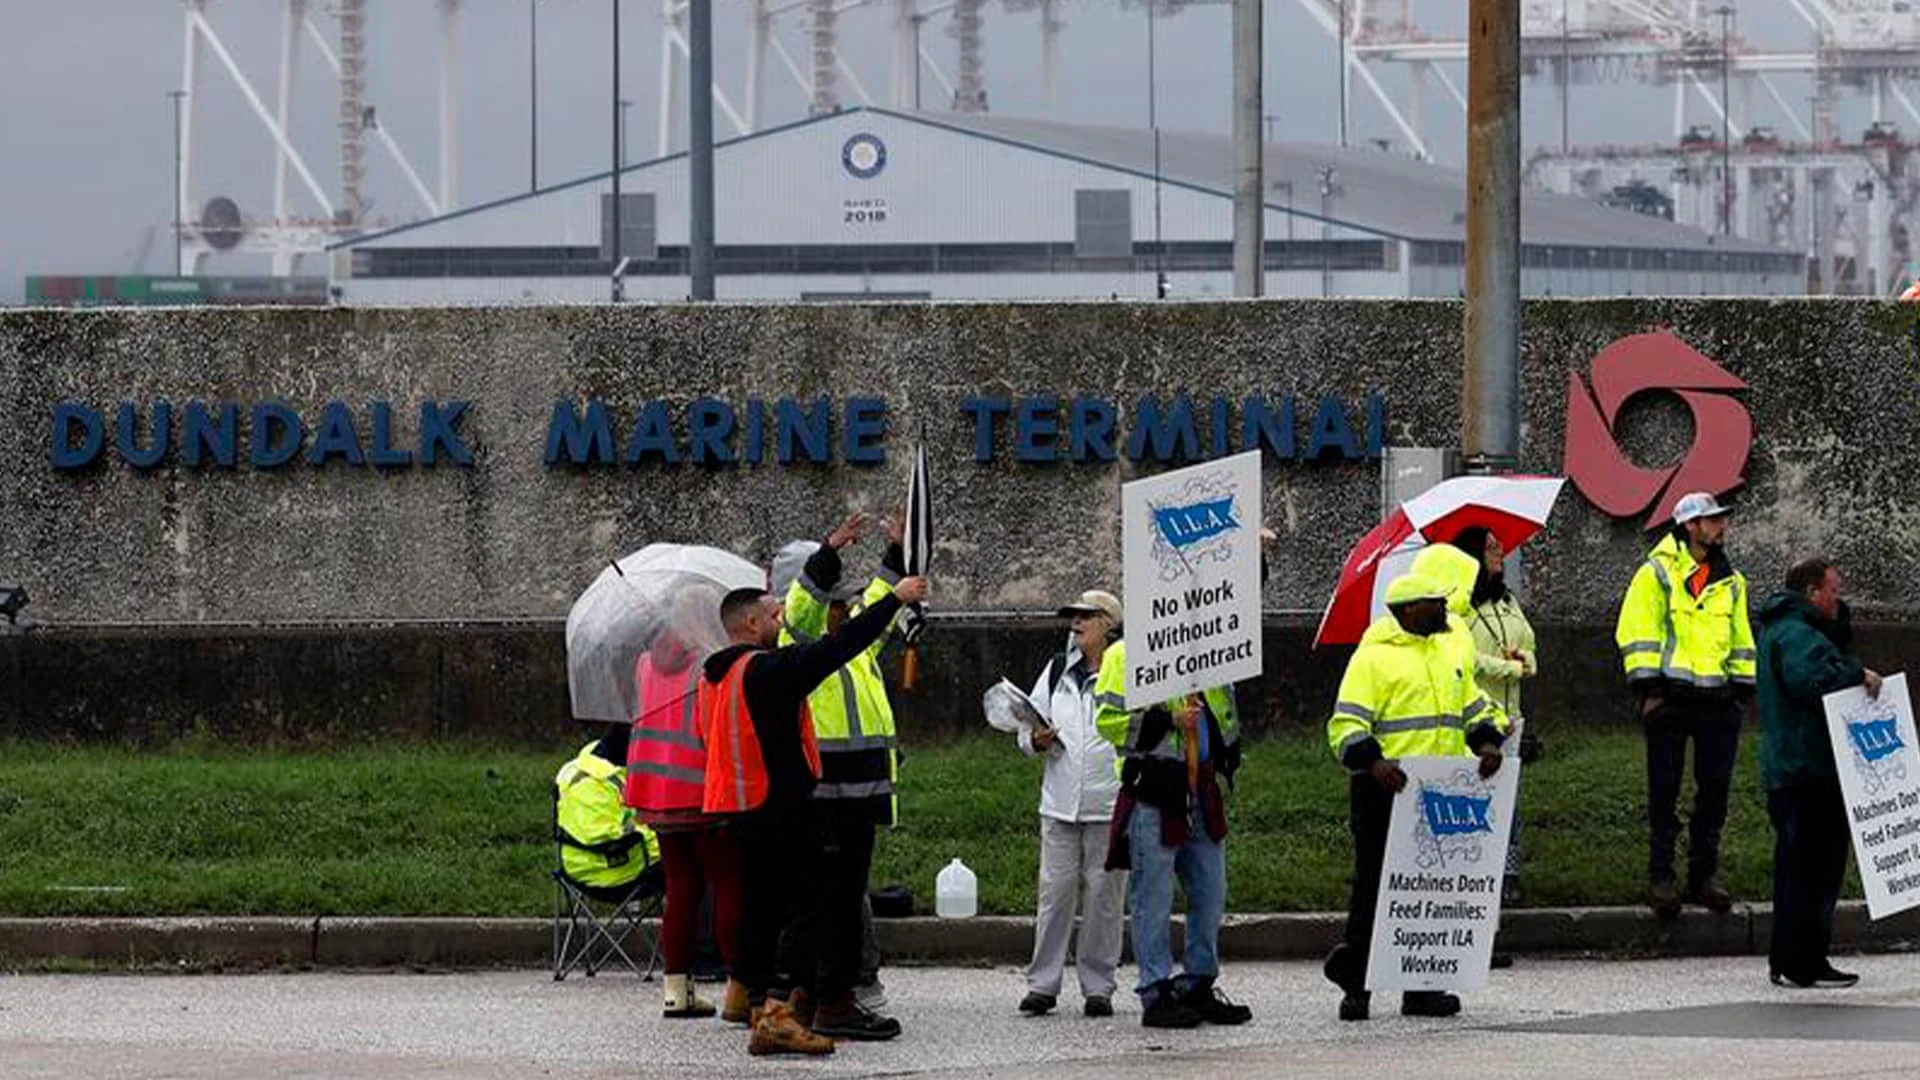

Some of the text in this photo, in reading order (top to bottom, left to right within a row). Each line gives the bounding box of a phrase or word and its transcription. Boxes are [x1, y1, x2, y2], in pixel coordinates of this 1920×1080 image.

[50, 399, 473, 468] DUNDALK
[545, 396, 887, 465] MARINE
[1169, 508, 1230, 538] I.L.A.
[1152, 579, 1234, 620] No Work
[1147, 613, 1240, 652] Without a
[1135, 639, 1254, 688] Fair Contract
[1852, 798, 1898, 823] Machines
[1861, 825, 1885, 849] Feed
[1872, 848, 1912, 874] Support
[1388, 872, 1496, 894] Machines Don't
[1388, 900, 1488, 920] Feed Families:
[1393, 927, 1475, 951] Support ILA
[1401, 954, 1458, 974] Workers
